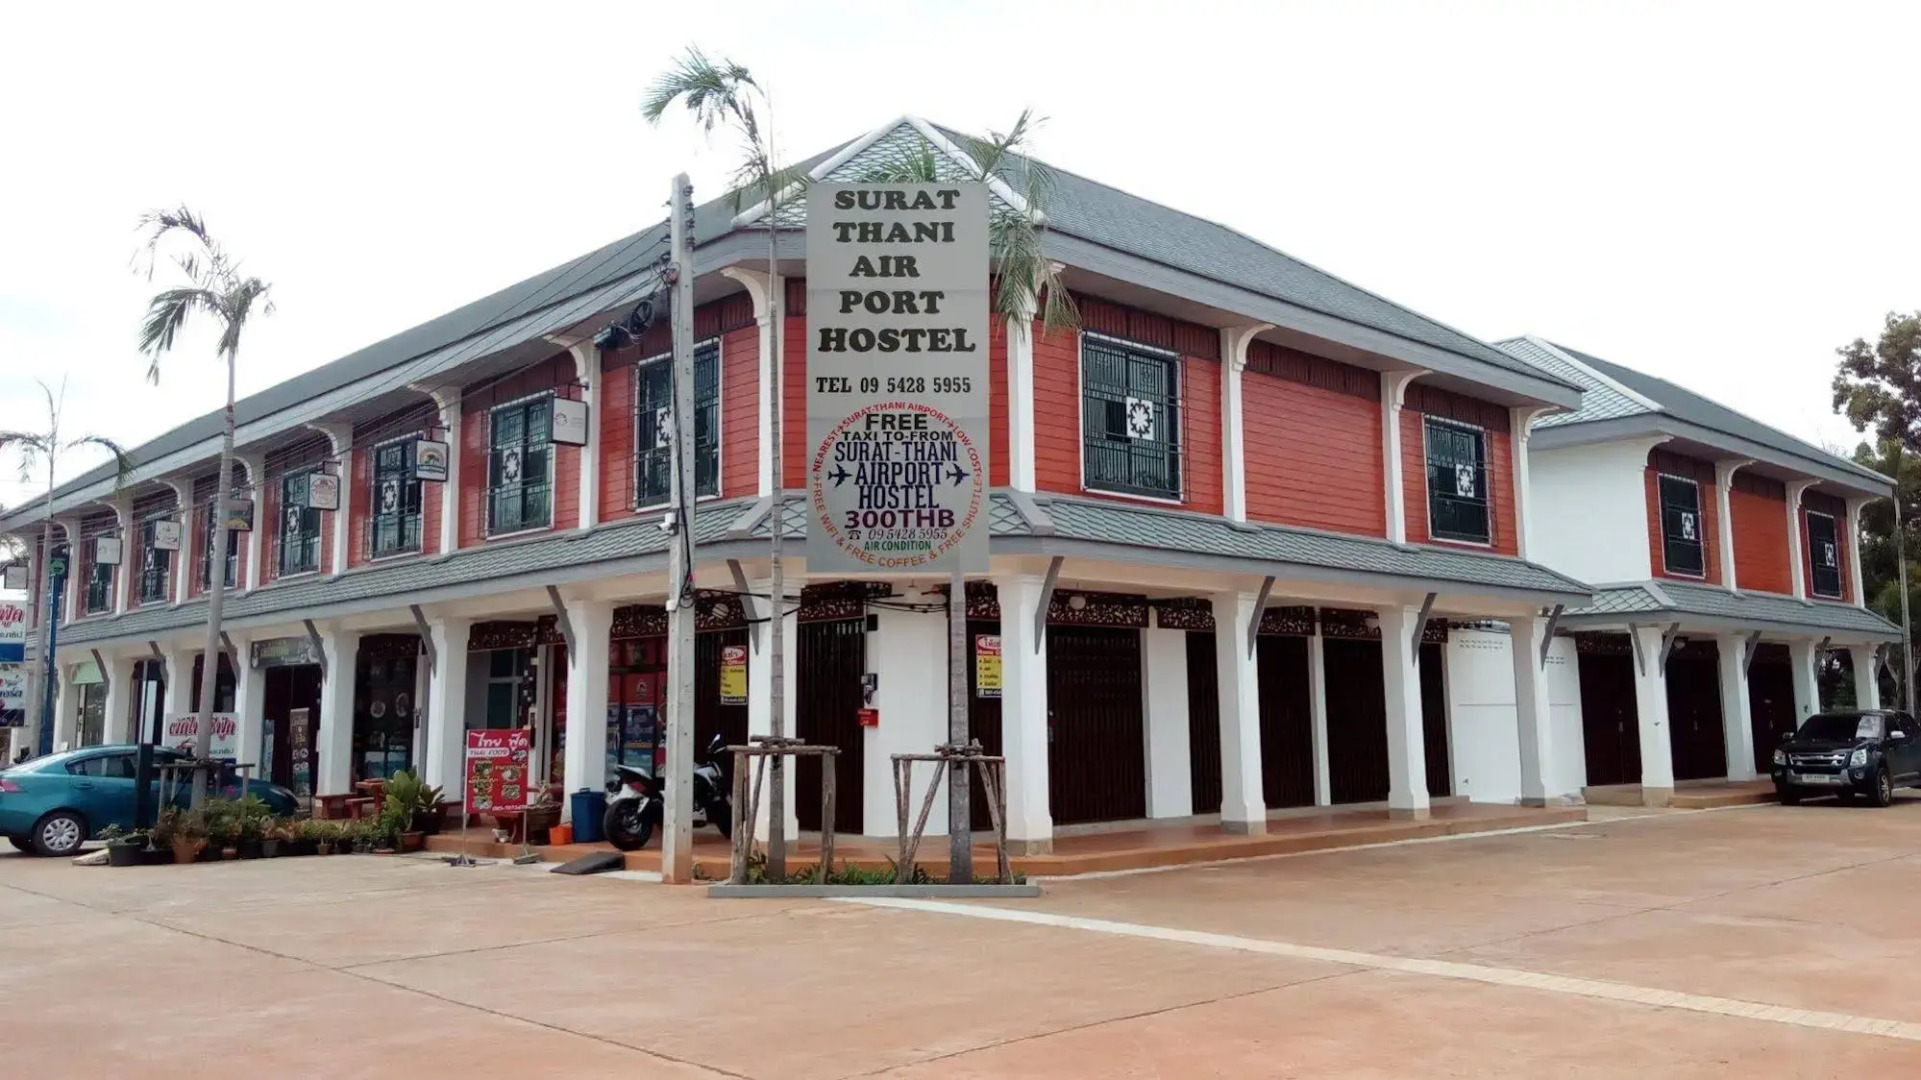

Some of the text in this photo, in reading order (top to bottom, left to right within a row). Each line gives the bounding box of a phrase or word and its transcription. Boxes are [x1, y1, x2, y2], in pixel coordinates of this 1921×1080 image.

[834, 189, 961, 210] SURAT
[833, 221, 956, 243] THANI
[849, 255, 921, 278] AIR
[839, 290, 945, 315] PORT
[818, 328, 976, 353] HOSTEL
[816, 377, 972, 394] TEL 09 5428 5955
[865, 413, 928, 431] FREE
[812, 431, 839, 473] NEAREST
[908, 402, 949, 425] AIRPORT
[953, 425, 971, 446] LOW
[967, 447, 983, 474] COST
[842, 431, 953, 441] TAXI TO-FROM
[854, 462, 943, 486] AIRPORT
[858, 485, 940, 509] HOSTEL
[813, 482, 825, 512] FREE
[836, 536, 845, 547] &
[845, 542, 875, 564] FREE
[878, 555, 927, 568] COFFEE
[929, 551, 938, 561] &
[937, 529, 964, 554] FREE
[961, 478, 983, 529] SHUTTLE
[845, 509, 955, 529] 300THB
[919, 528, 948, 540] 5955
[864, 540, 931, 551] AIR CONDITION
